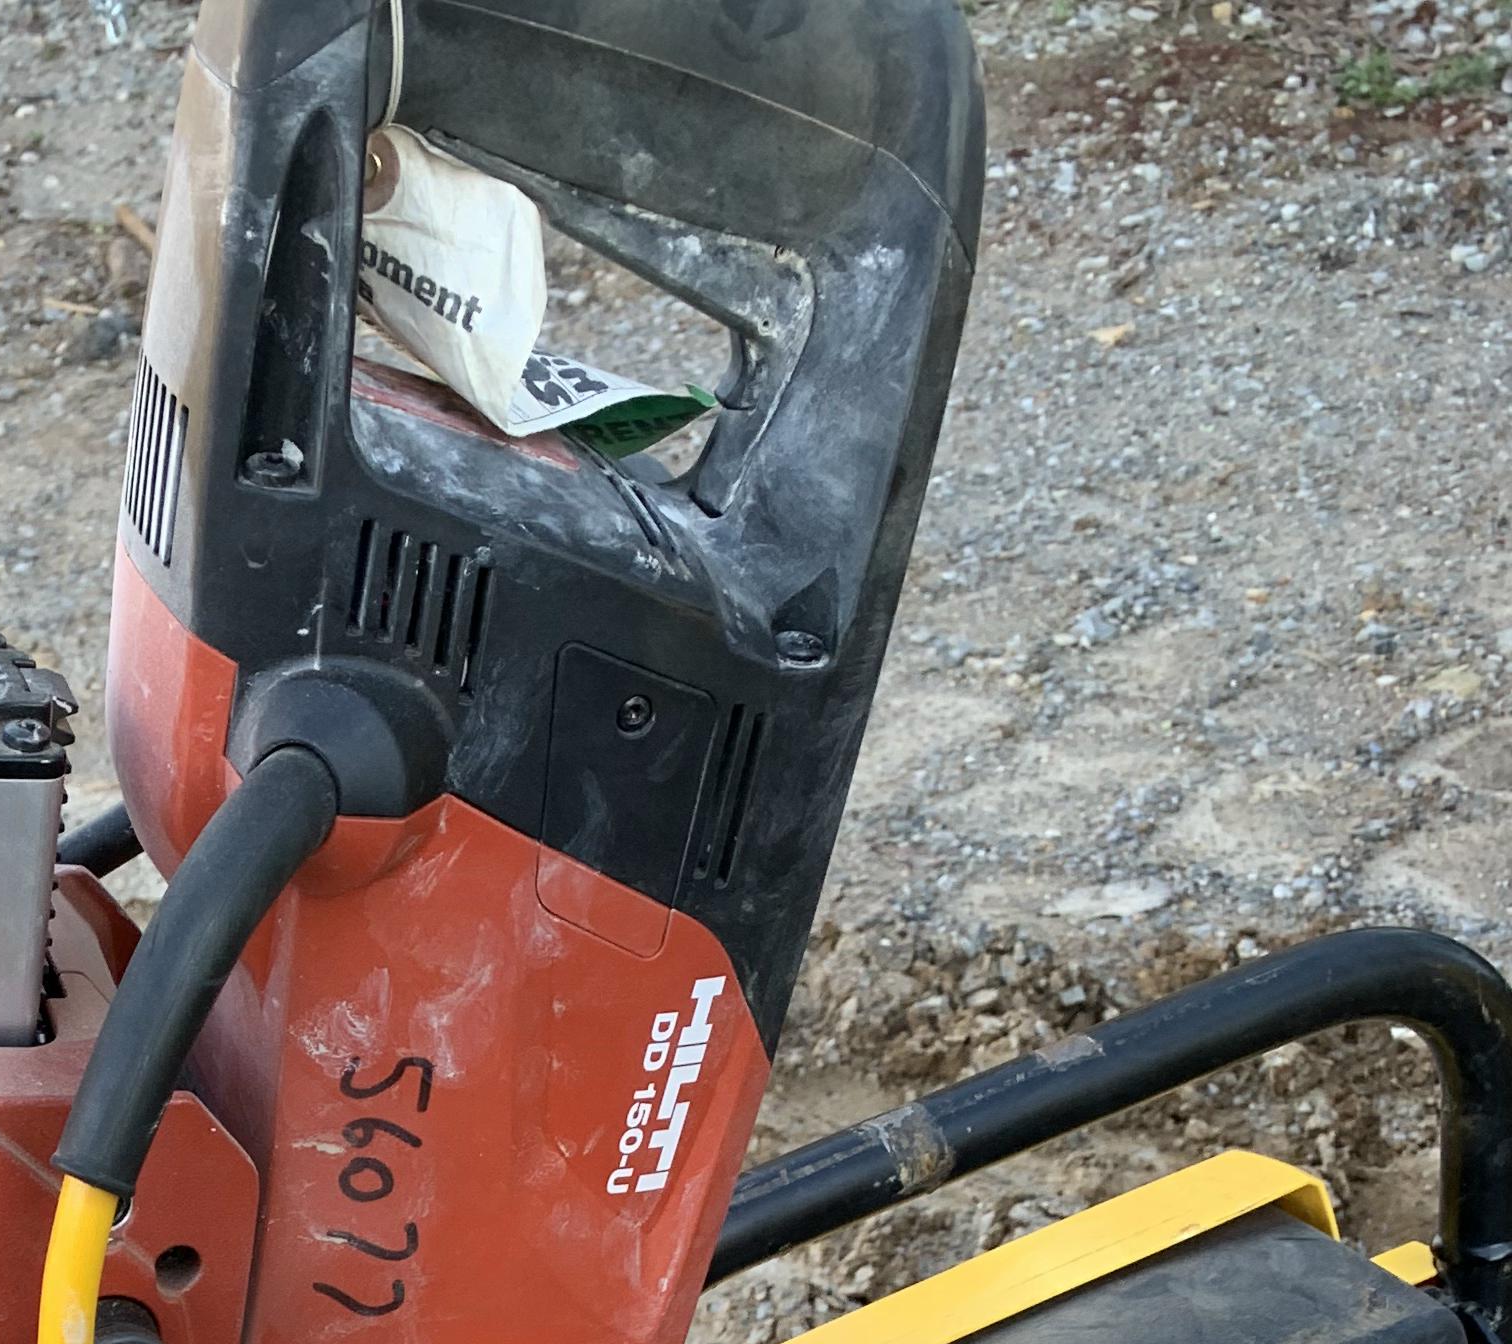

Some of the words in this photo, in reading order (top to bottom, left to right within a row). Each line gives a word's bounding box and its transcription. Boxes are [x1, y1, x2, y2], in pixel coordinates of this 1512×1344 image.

[359, 237, 482, 333] pment
[635, 975, 728, 1194] HILTI
[642, 1011, 679, 1073] DD
[311, 1056, 434, 1318] 56077
[606, 1082, 656, 1195] 150-U
